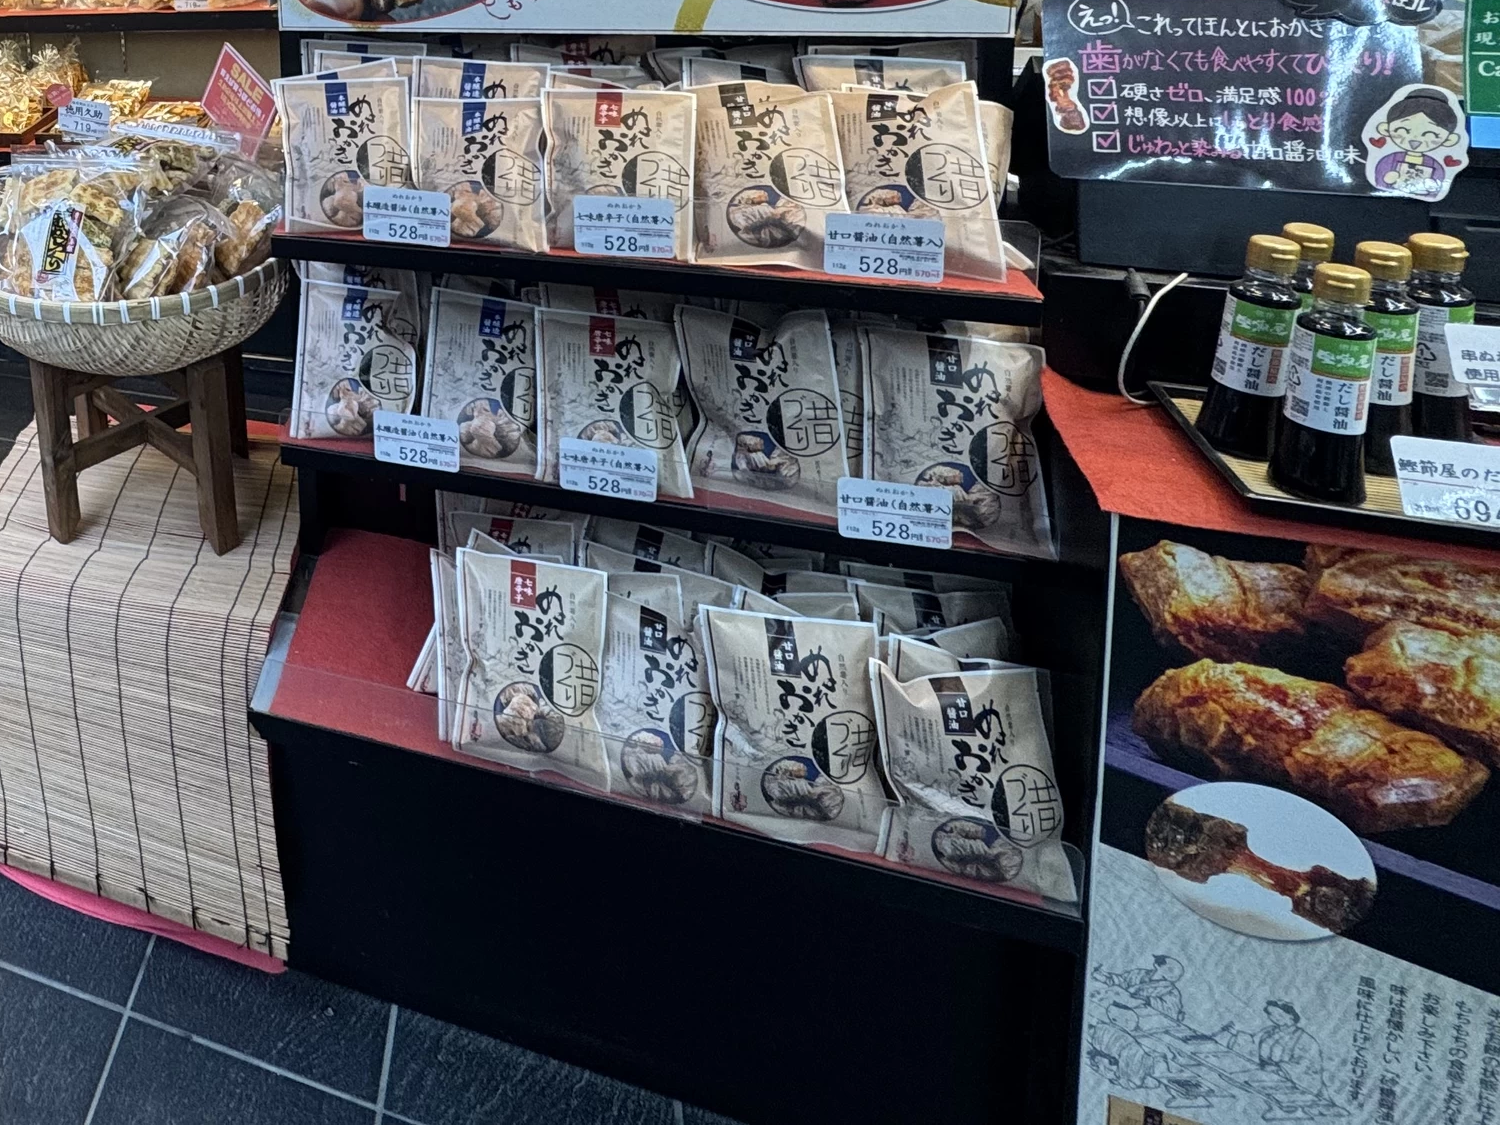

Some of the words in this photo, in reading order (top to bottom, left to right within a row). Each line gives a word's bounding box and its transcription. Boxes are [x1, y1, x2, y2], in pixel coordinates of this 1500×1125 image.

[230, 62, 265, 105] SALE
[65, 104, 104, 120] 徳用久助
[1244, 346, 1267, 391] だし醤油
[1377, 355, 1396, 401] だし醤油
[1332, 382, 1354, 430] だし醤油
[1455, 497, 1500, 523] 69
